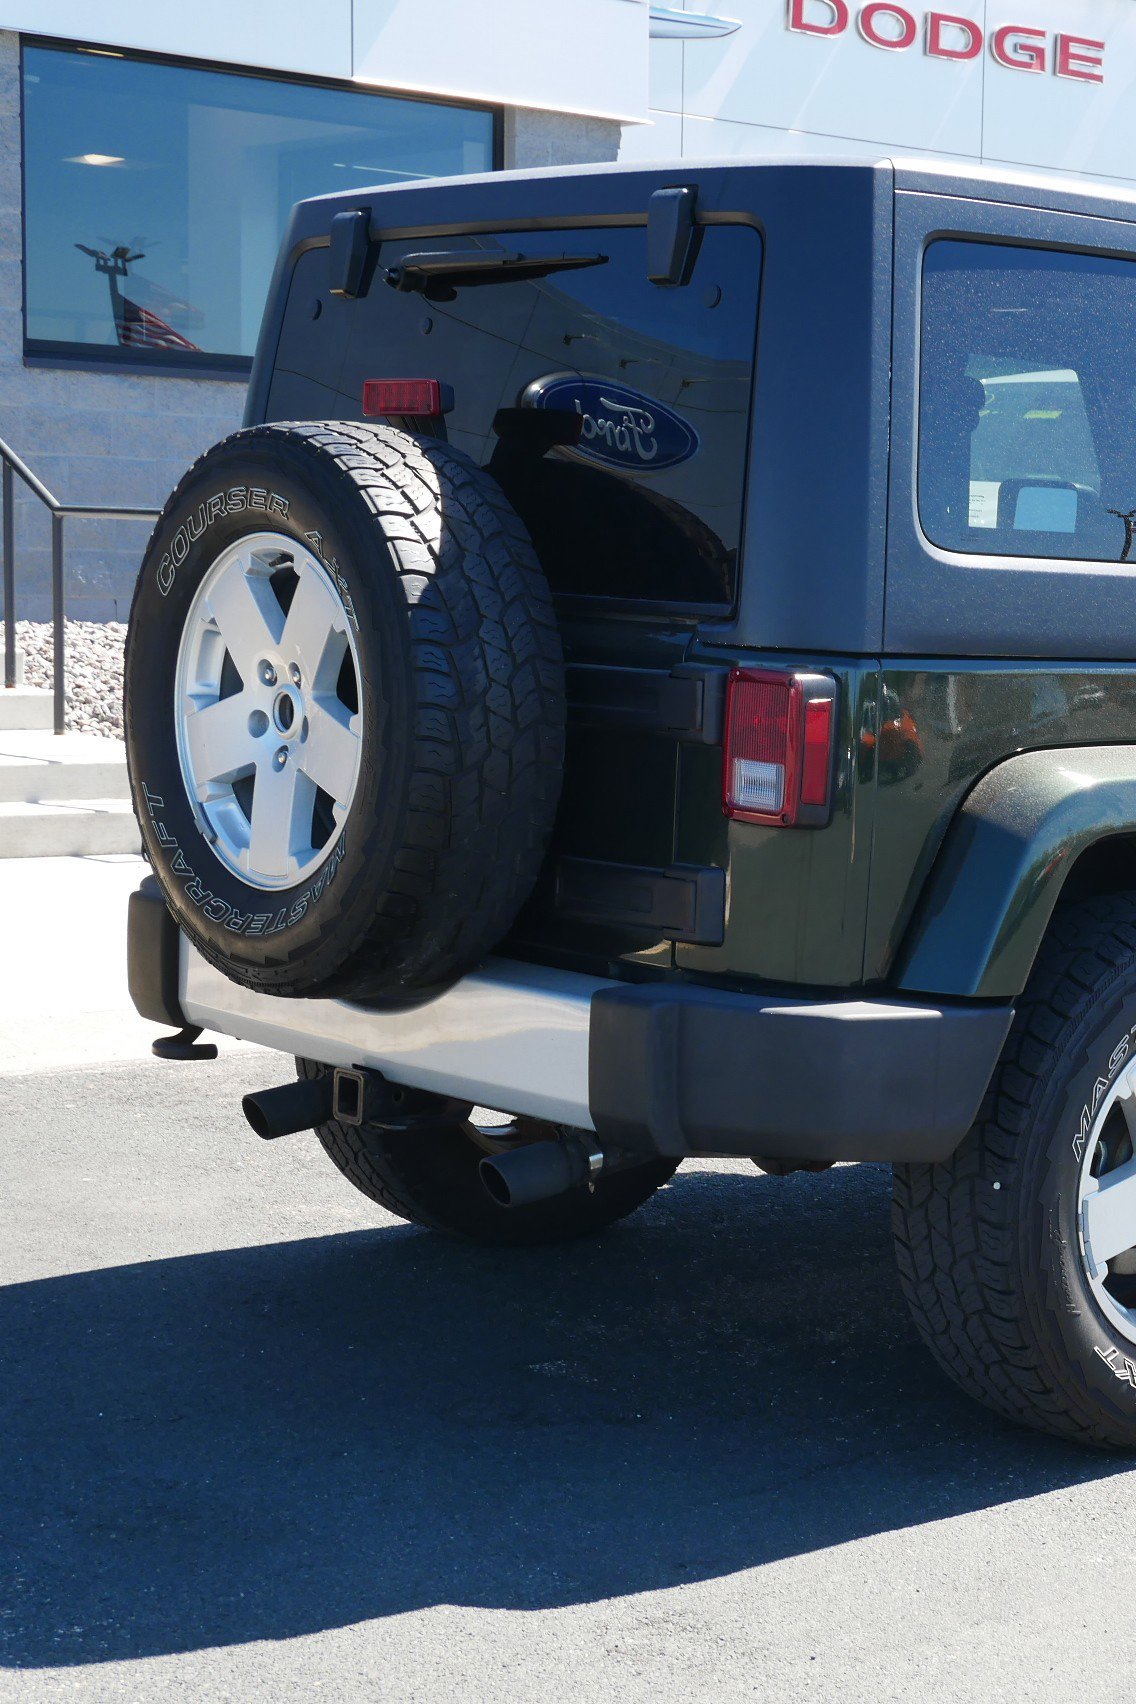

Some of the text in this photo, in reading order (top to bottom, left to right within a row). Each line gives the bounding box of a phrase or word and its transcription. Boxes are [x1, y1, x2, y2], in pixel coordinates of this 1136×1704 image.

[787, 0, 1105, 84] DODGE
[156, 486, 289, 596] COURSER
[142, 781, 347, 936] MASTERCRAFT
